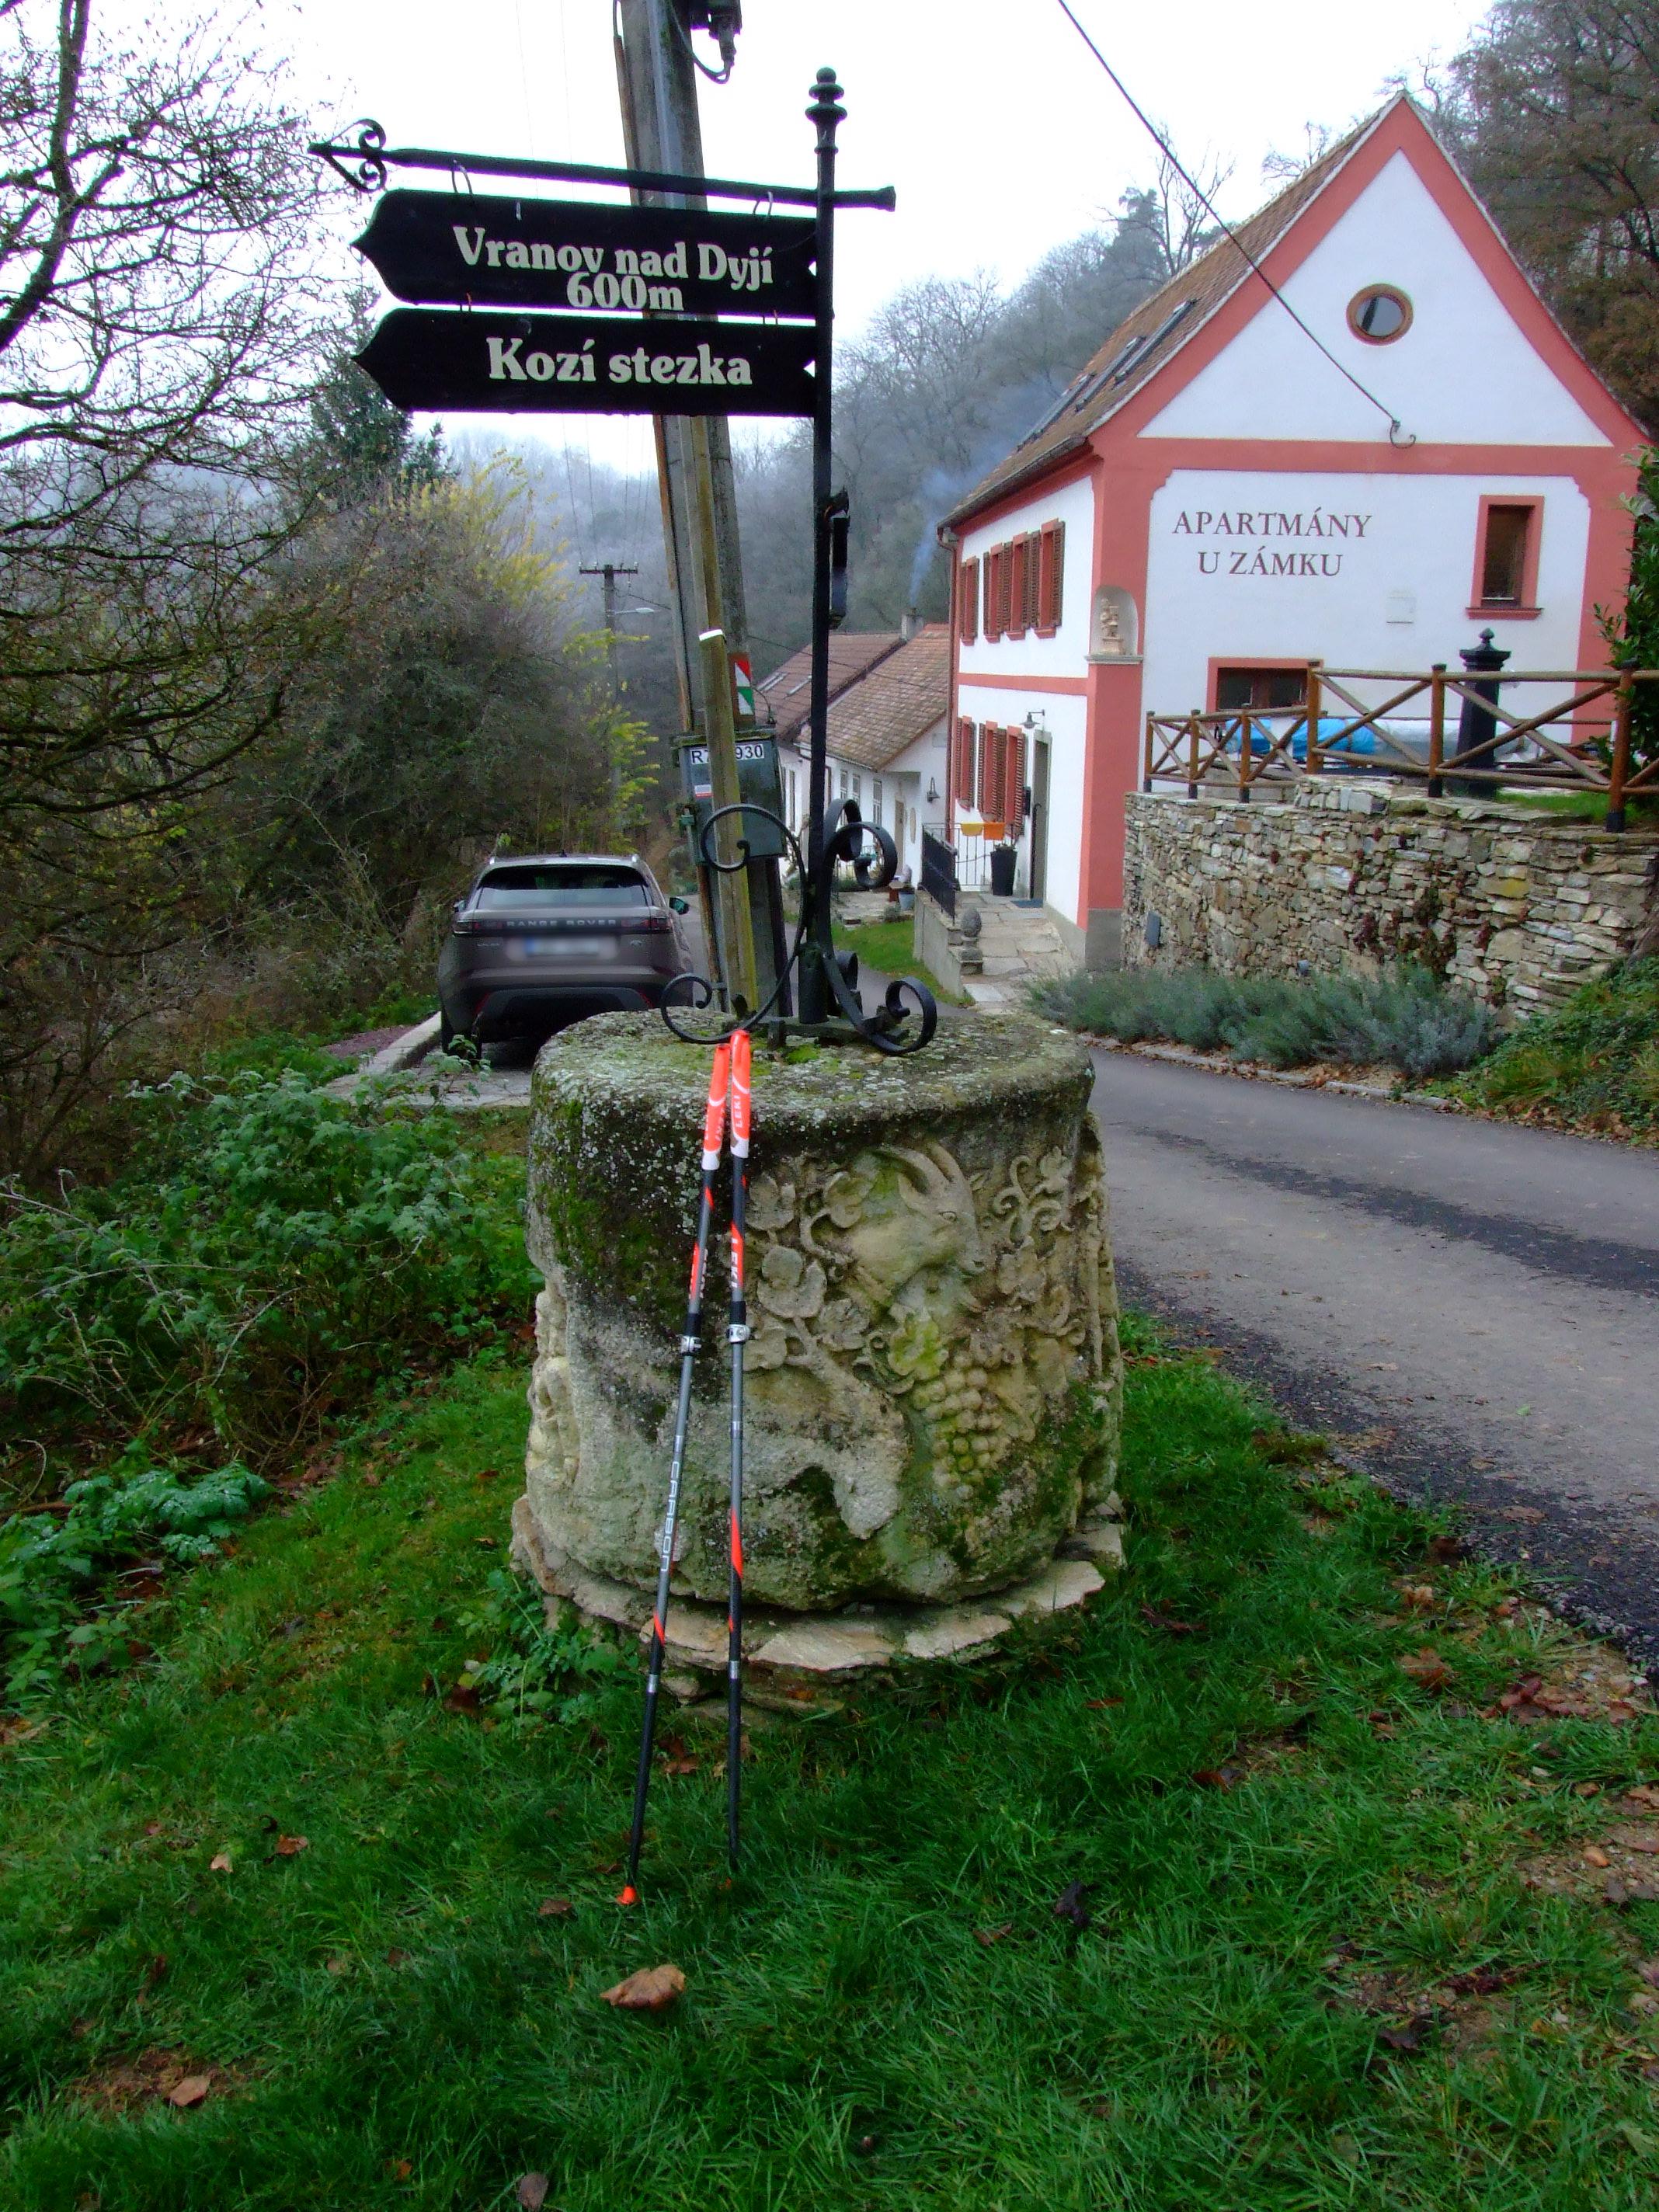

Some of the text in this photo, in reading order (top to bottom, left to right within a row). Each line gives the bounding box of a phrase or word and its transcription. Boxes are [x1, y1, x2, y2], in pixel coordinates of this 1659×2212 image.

[453, 225, 773, 290] Vranov nad Dyjí
[565, 272, 684, 312] 600m
[485, 337, 753, 386] Kozí stezka
[1171, 506, 1372, 538] APARTMÁNY
[1198, 545, 1344, 577] U ZÁMKU
[566, 918, 617, 927] ROVER
[733, 1094, 743, 1129] LEKI
[660, 1461, 680, 1572] CARBON
